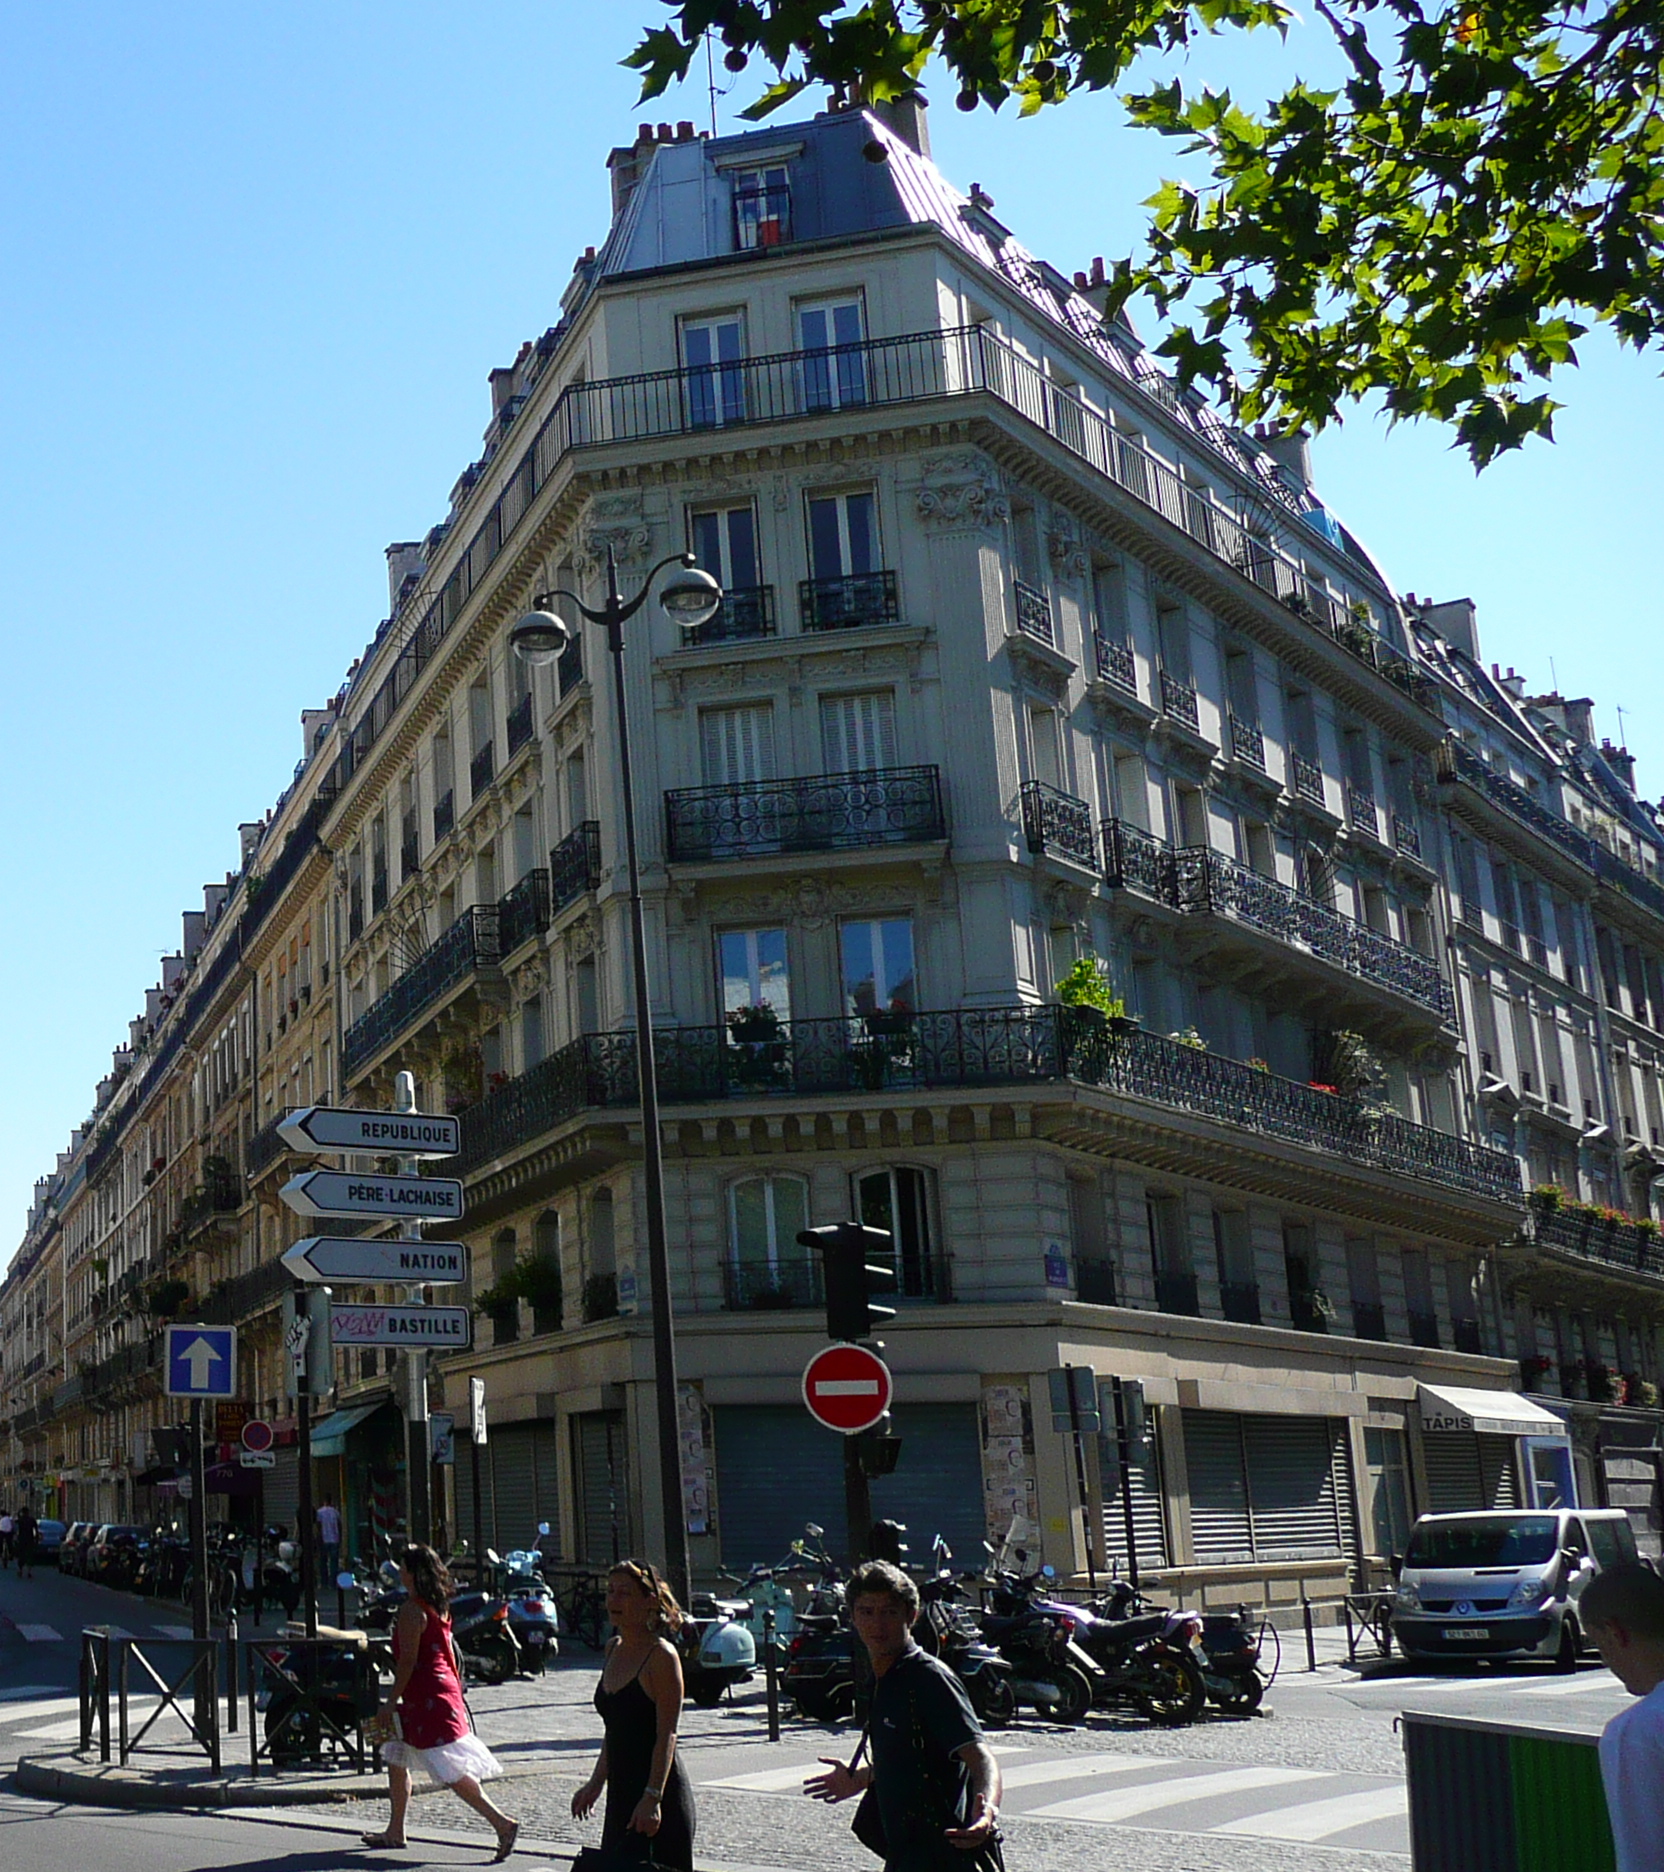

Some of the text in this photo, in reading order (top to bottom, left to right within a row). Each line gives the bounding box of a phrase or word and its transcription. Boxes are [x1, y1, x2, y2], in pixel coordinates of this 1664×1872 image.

[361, 1121, 452, 1144] REPUBLIQUE
[399, 1253, 458, 1271] NATION
[388, 1317, 461, 1335] BASTILLE
